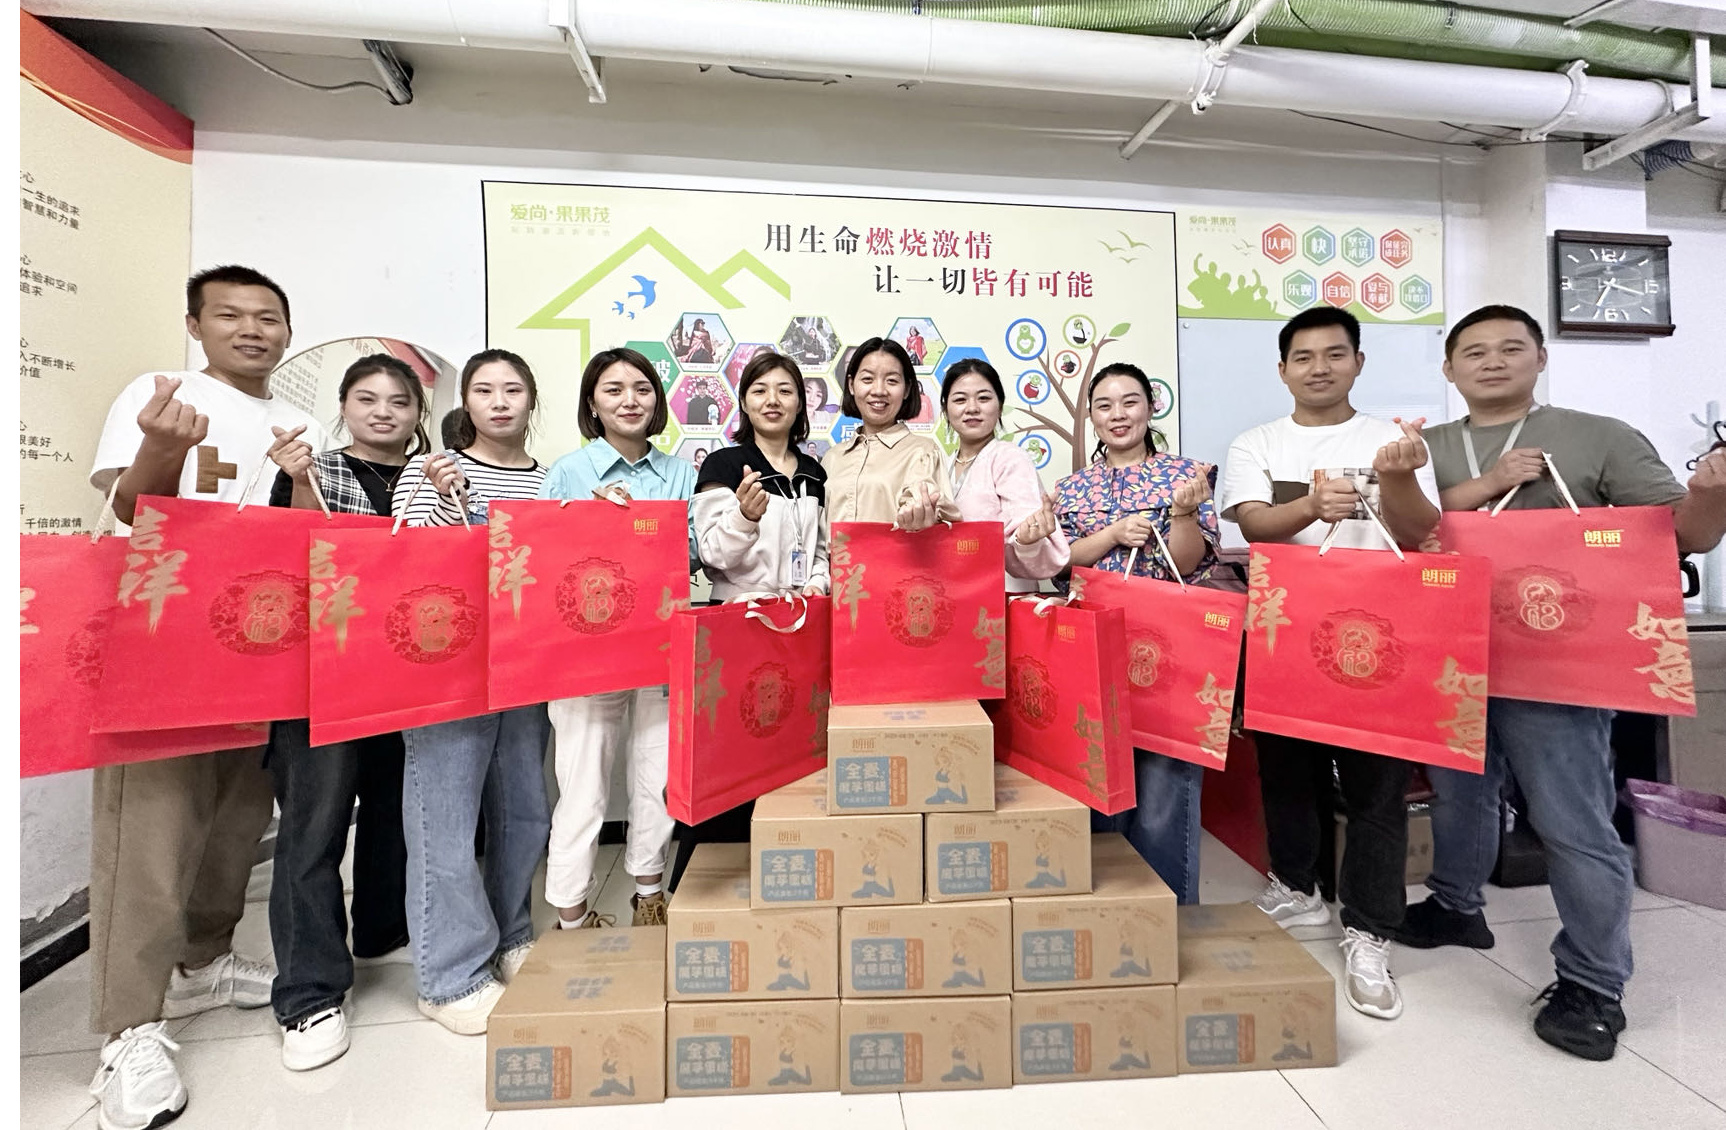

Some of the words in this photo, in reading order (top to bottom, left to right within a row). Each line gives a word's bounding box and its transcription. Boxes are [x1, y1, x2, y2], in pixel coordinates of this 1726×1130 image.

[764, 223, 993, 260] 用生命燃烧激情
[1267, 236, 1292, 251] 认真
[873, 264, 1094, 299] 让一切皆有可能
[1326, 285, 1351, 299] 自信
[25, 517, 82, 529] 千倍的激情
